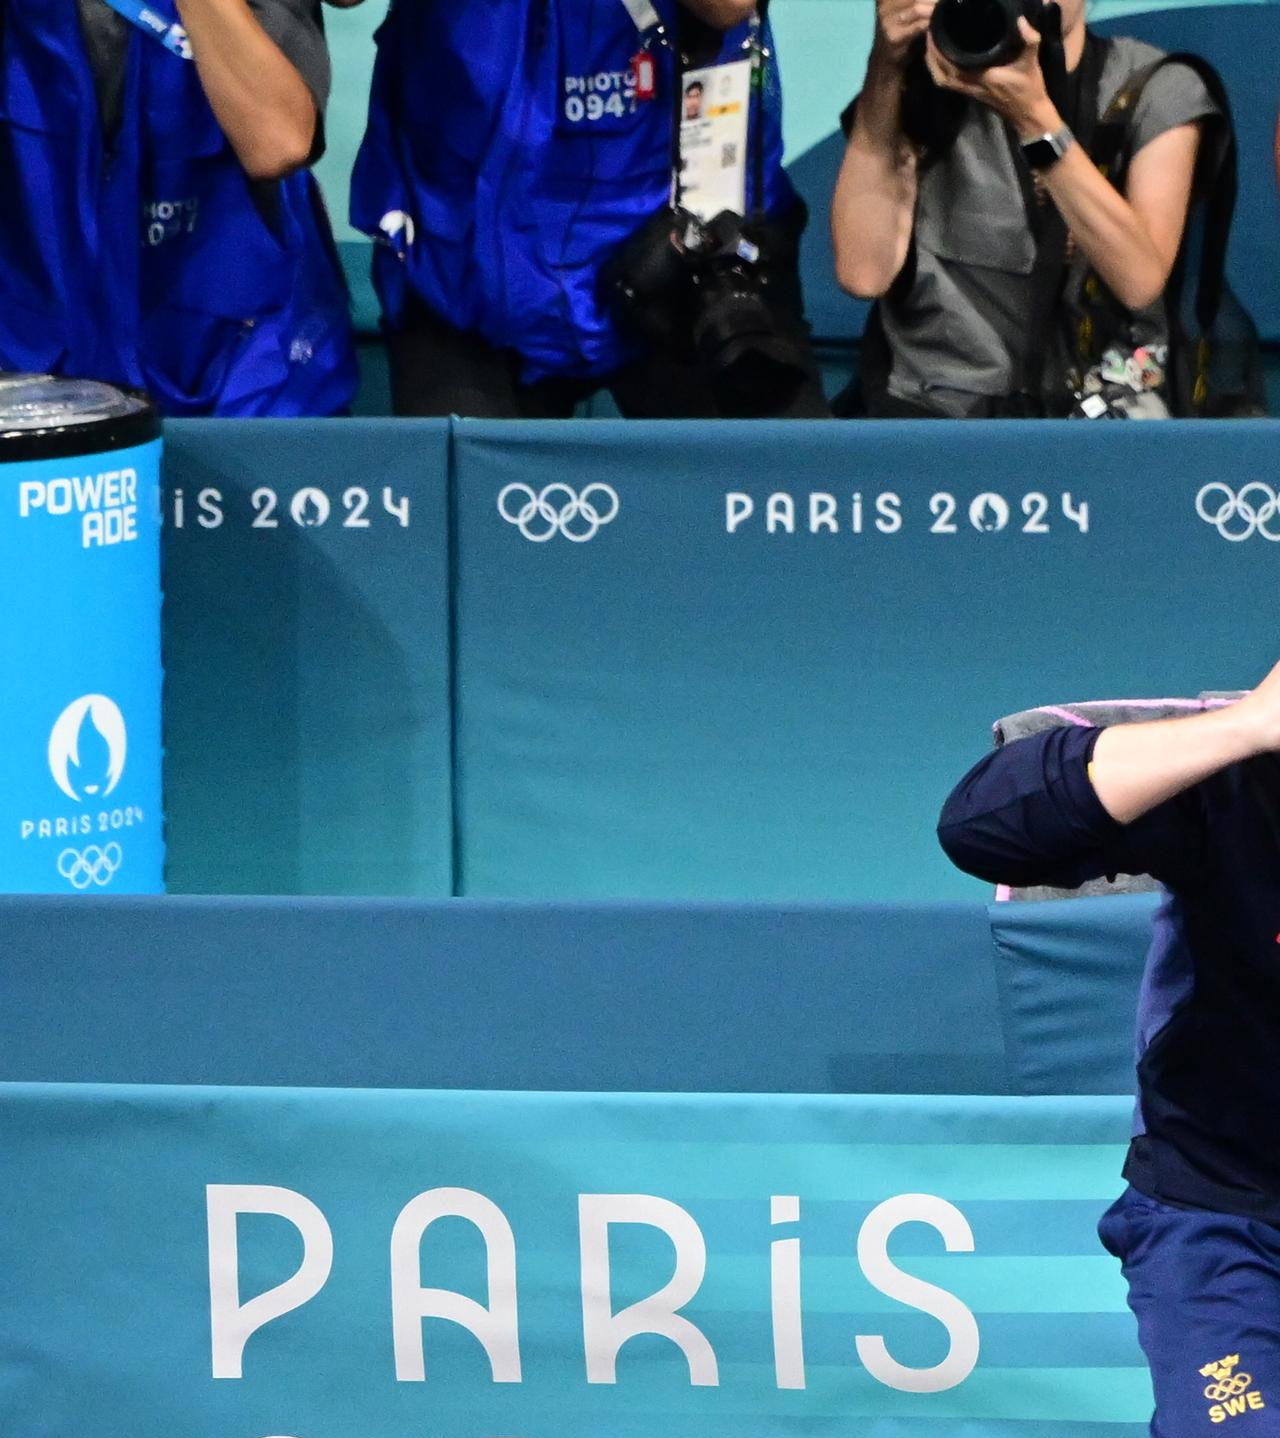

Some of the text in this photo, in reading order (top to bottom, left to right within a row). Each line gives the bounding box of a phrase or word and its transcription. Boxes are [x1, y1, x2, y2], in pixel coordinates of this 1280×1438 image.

[19, 468, 138, 517] POWER
[82, 504, 138, 549] ADE
[1208, 1391, 1265, 1424] SWE
